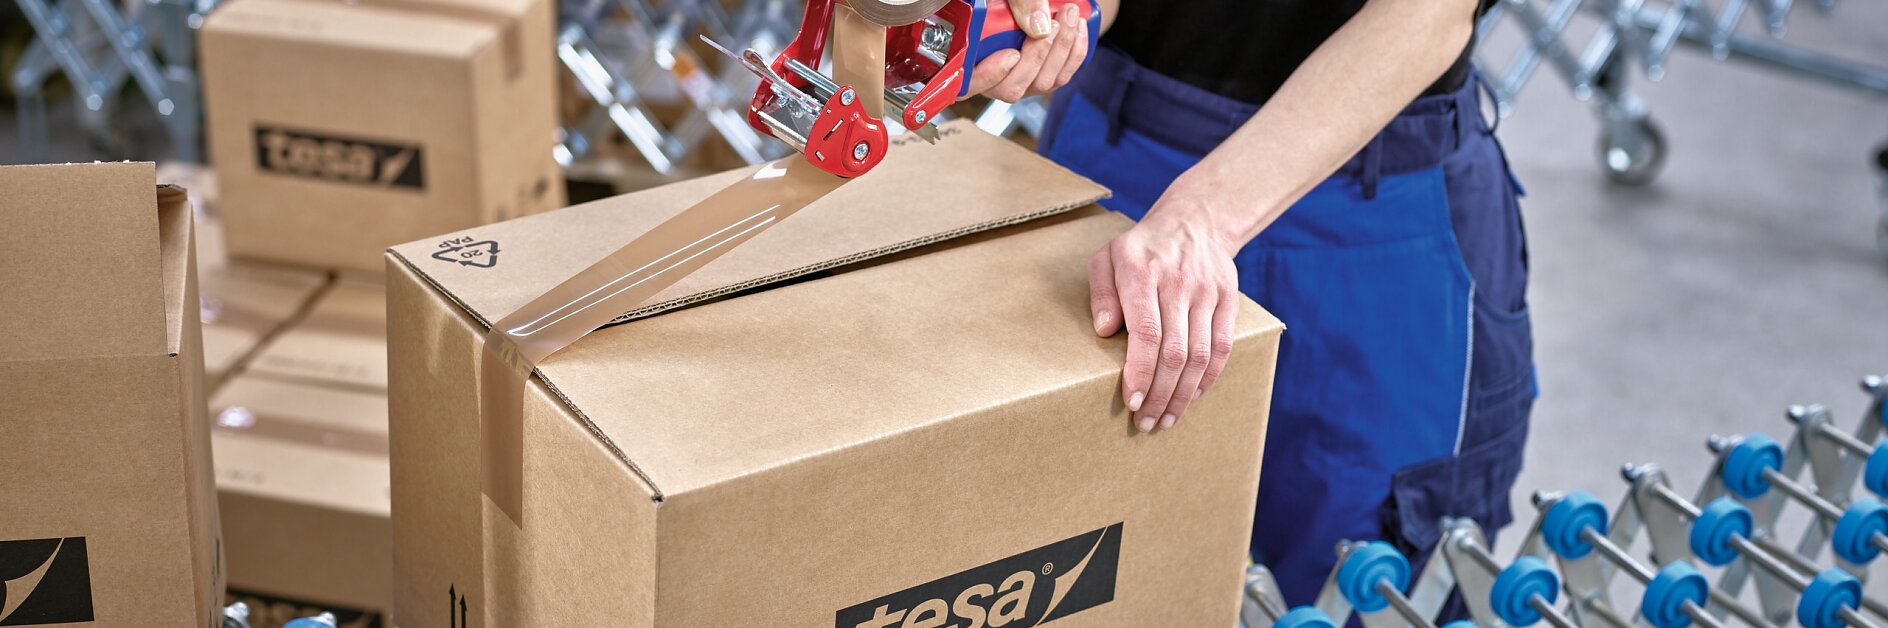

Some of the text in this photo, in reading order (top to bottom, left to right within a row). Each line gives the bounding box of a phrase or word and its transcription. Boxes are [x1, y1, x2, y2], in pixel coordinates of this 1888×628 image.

[264, 132, 375, 180] tesa
[438, 236, 474, 248] PAP
[461, 249, 483, 258] 20
